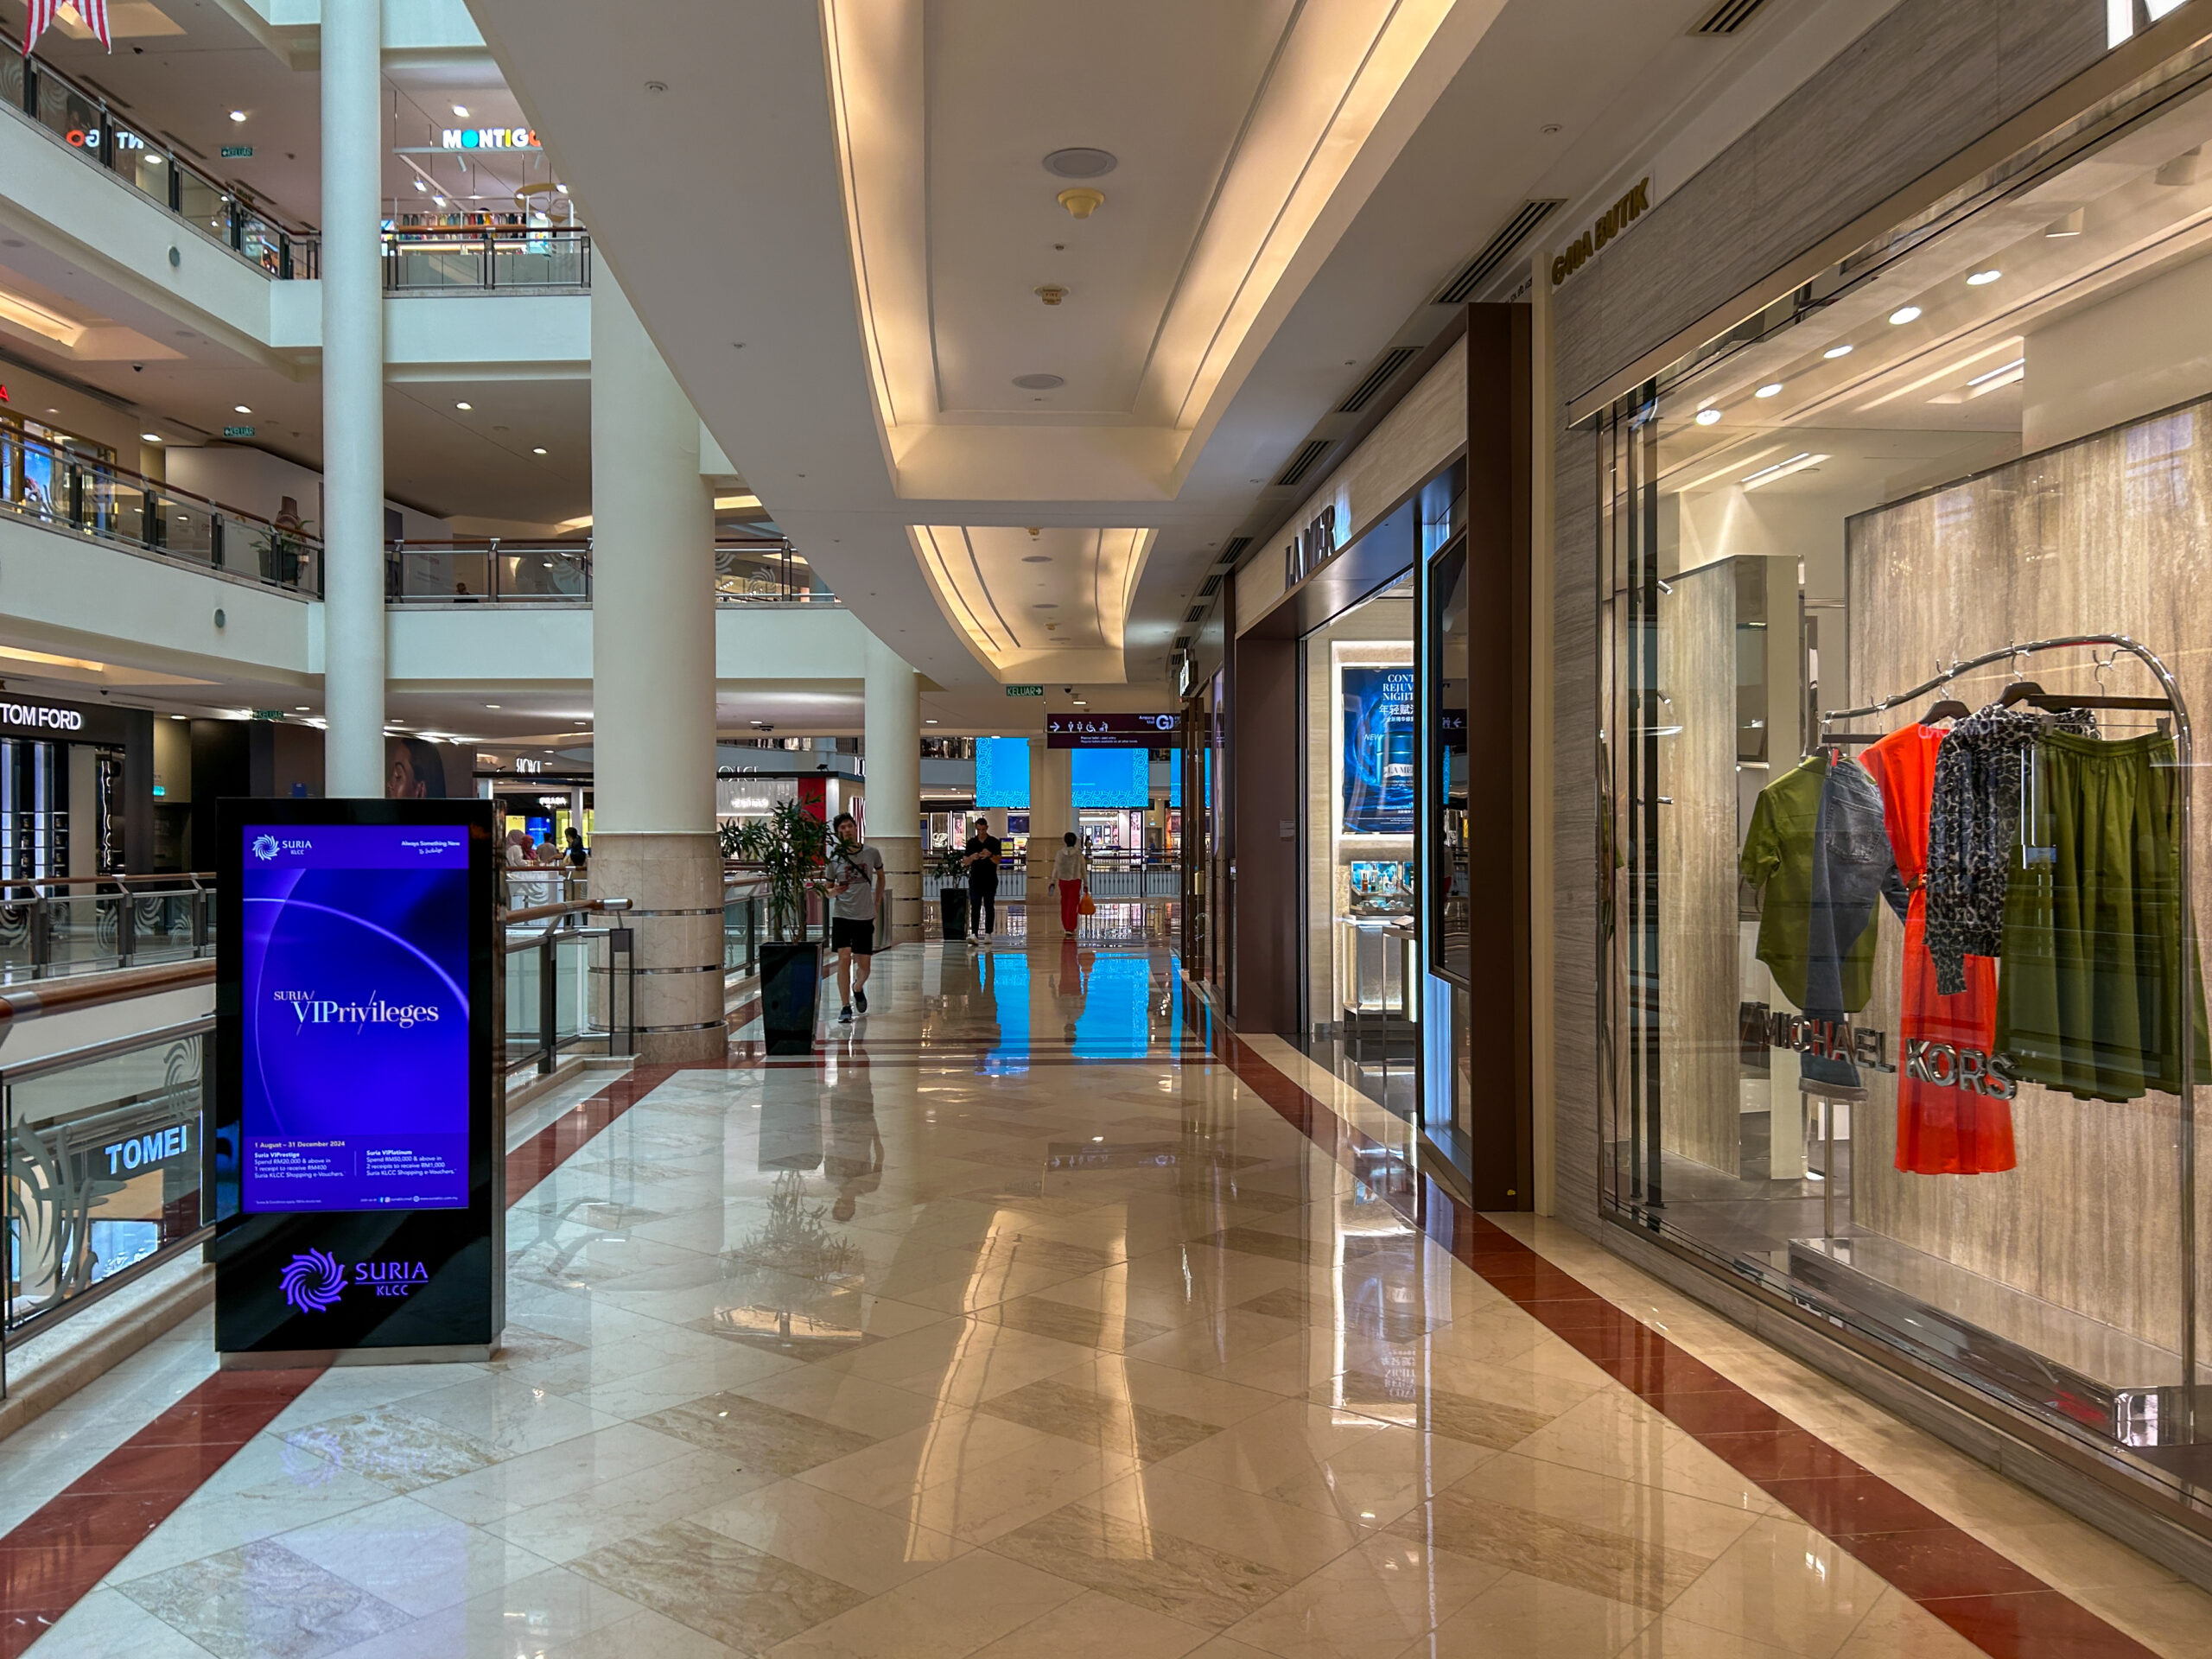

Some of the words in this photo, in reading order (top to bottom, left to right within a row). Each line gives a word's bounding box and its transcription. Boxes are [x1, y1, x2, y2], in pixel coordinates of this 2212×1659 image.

[1595, 177, 1649, 251] BUTIK
[1388, 674, 1414, 683] CONT
[1007, 687, 1035, 696] KELUAR
[1382, 692, 1414, 701] NIGHT
[0, 702, 35, 726] TOM
[39, 707, 81, 730] FORD
[282, 840, 312, 849] SURIA
[274, 991, 309, 1001] SURIA
[290, 1000, 439, 1029] VIPrivileges
[1760, 1007, 1896, 1073] MICHAEL
[1904, 1038, 2019, 1101] KORS
[105, 1125, 187, 1175] TOMEI
[355, 1262, 429, 1281] SURIA
[376, 1285, 408, 1296] KLCC
